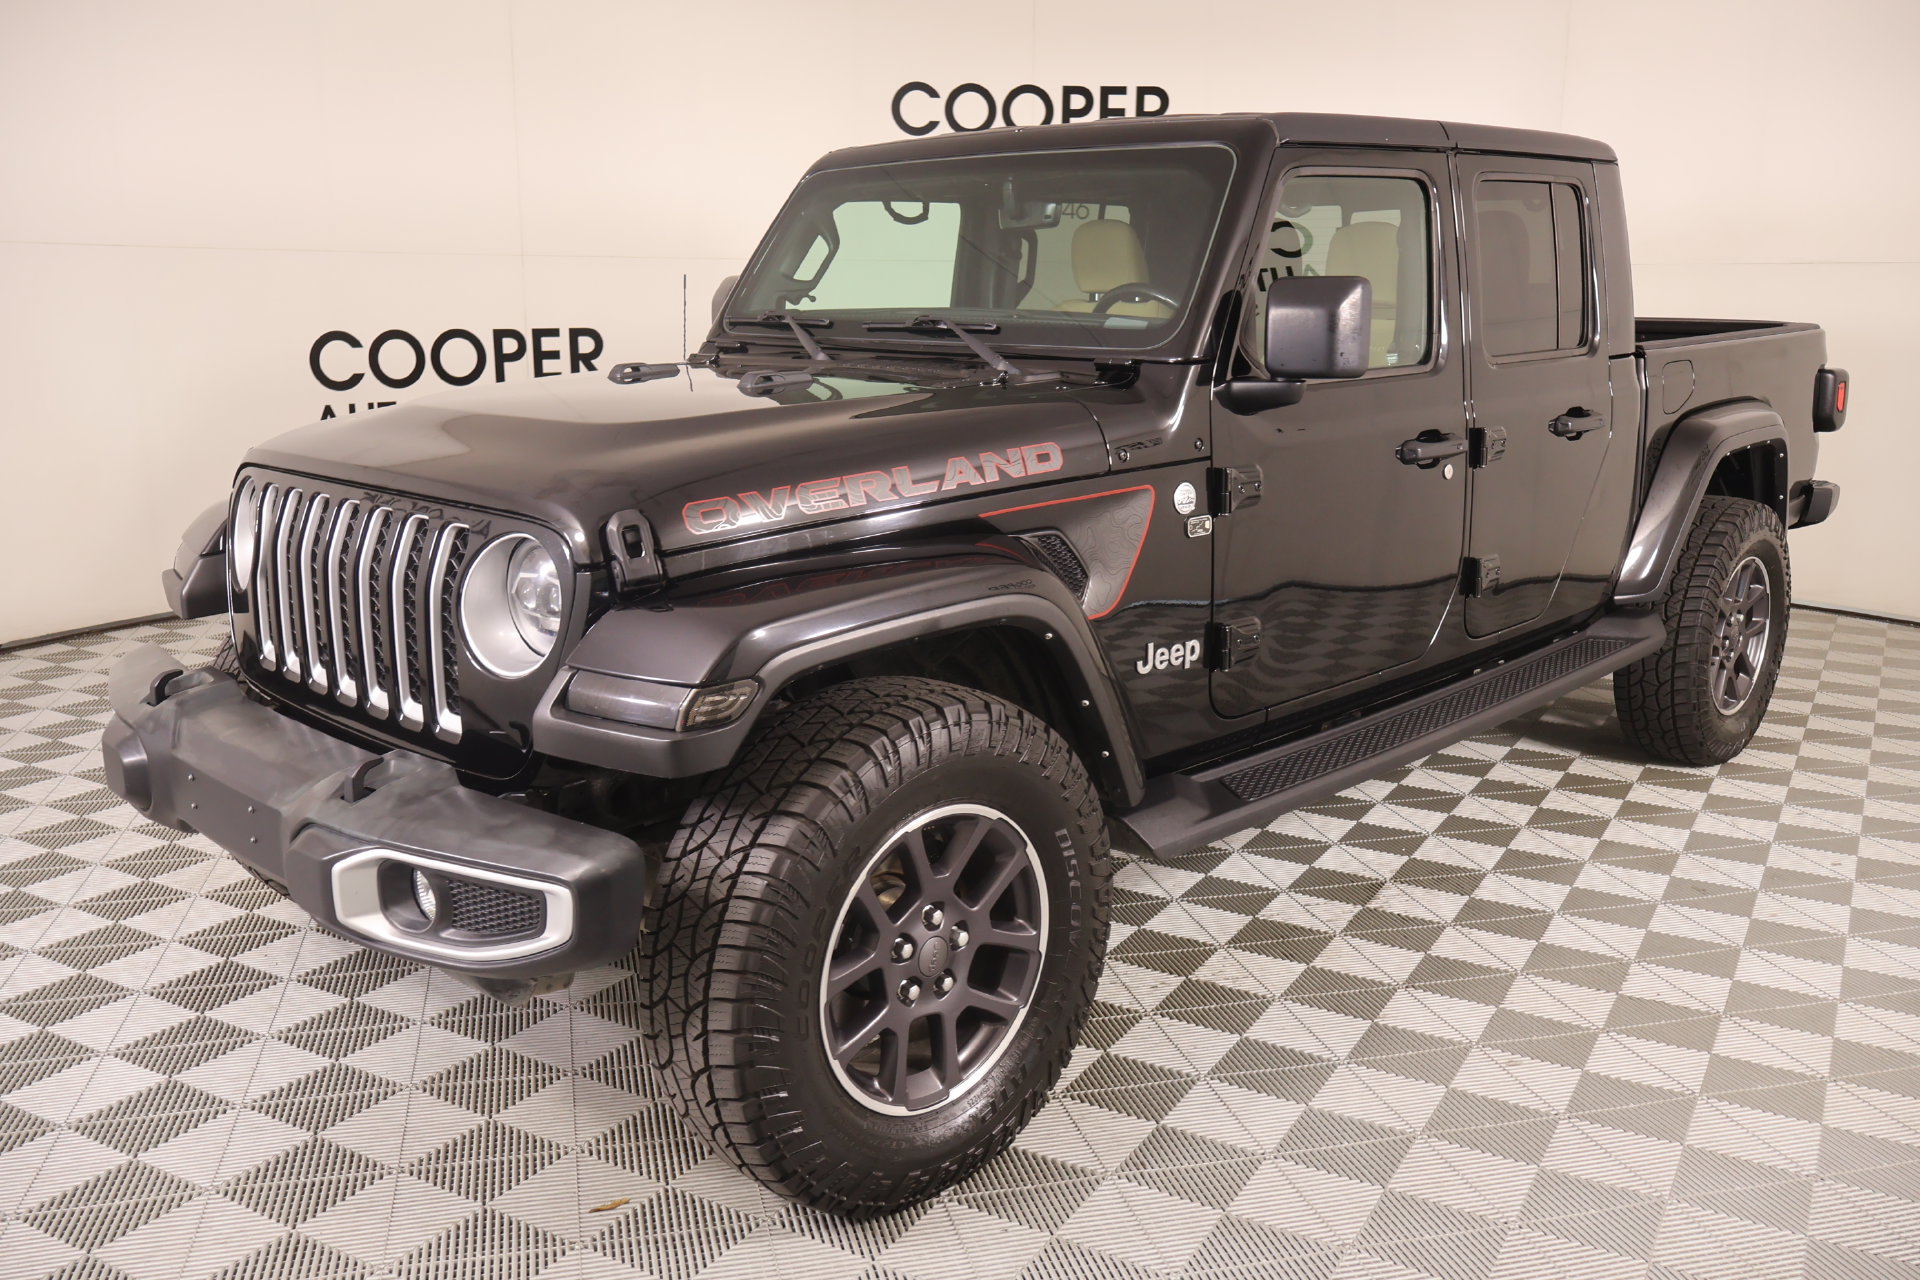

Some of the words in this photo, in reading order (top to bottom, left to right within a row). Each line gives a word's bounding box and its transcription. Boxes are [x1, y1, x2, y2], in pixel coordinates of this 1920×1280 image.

[891, 81, 1169, 136] COOPER
[309, 327, 604, 391] COOPER
[681, 441, 1064, 535] OVERLAND
[1136, 638, 1200, 675] Jeep
